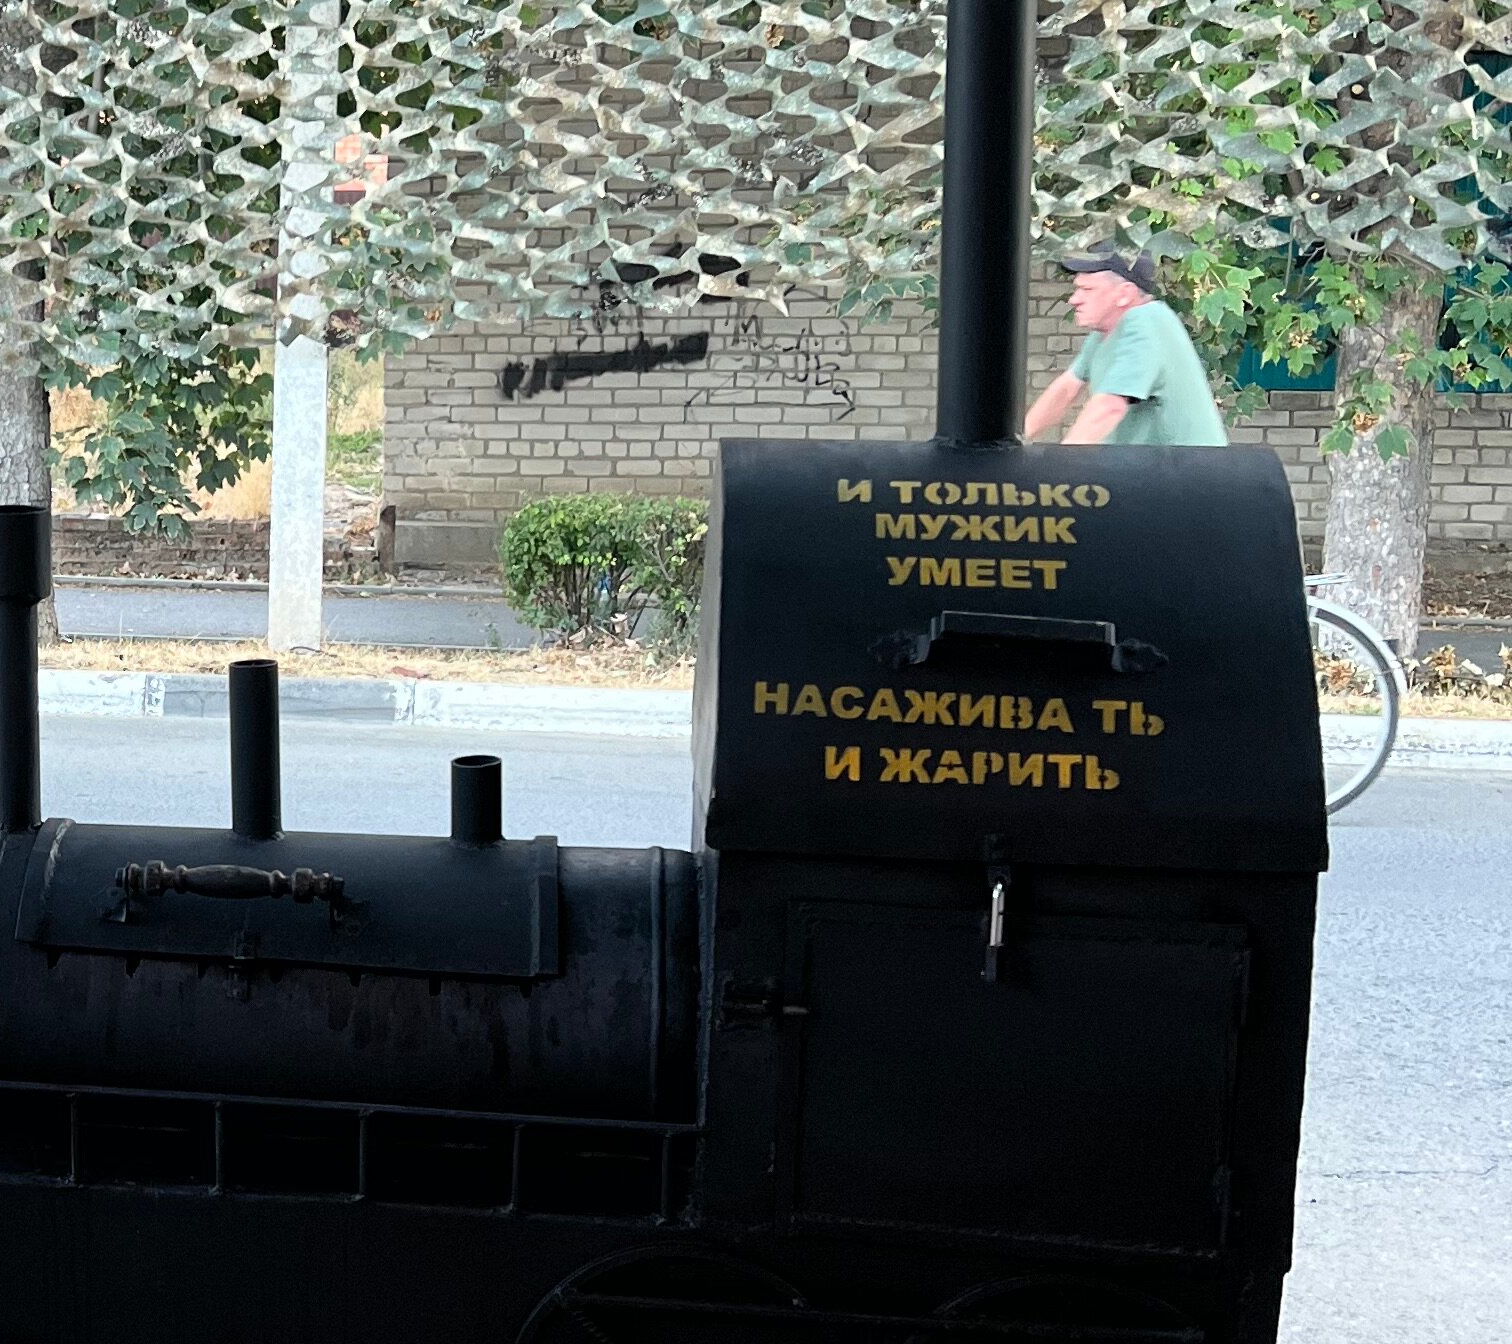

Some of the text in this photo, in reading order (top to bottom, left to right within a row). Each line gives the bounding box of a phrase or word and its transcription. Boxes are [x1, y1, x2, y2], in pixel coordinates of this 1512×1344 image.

[838, 479, 1110, 508] И ТОЛЬКО
[875, 513, 1077, 544] МУЖИК
[887, 557, 1066, 589] УМЕЕТ
[825, 746, 1120, 790] И ЖАРИТЬ
